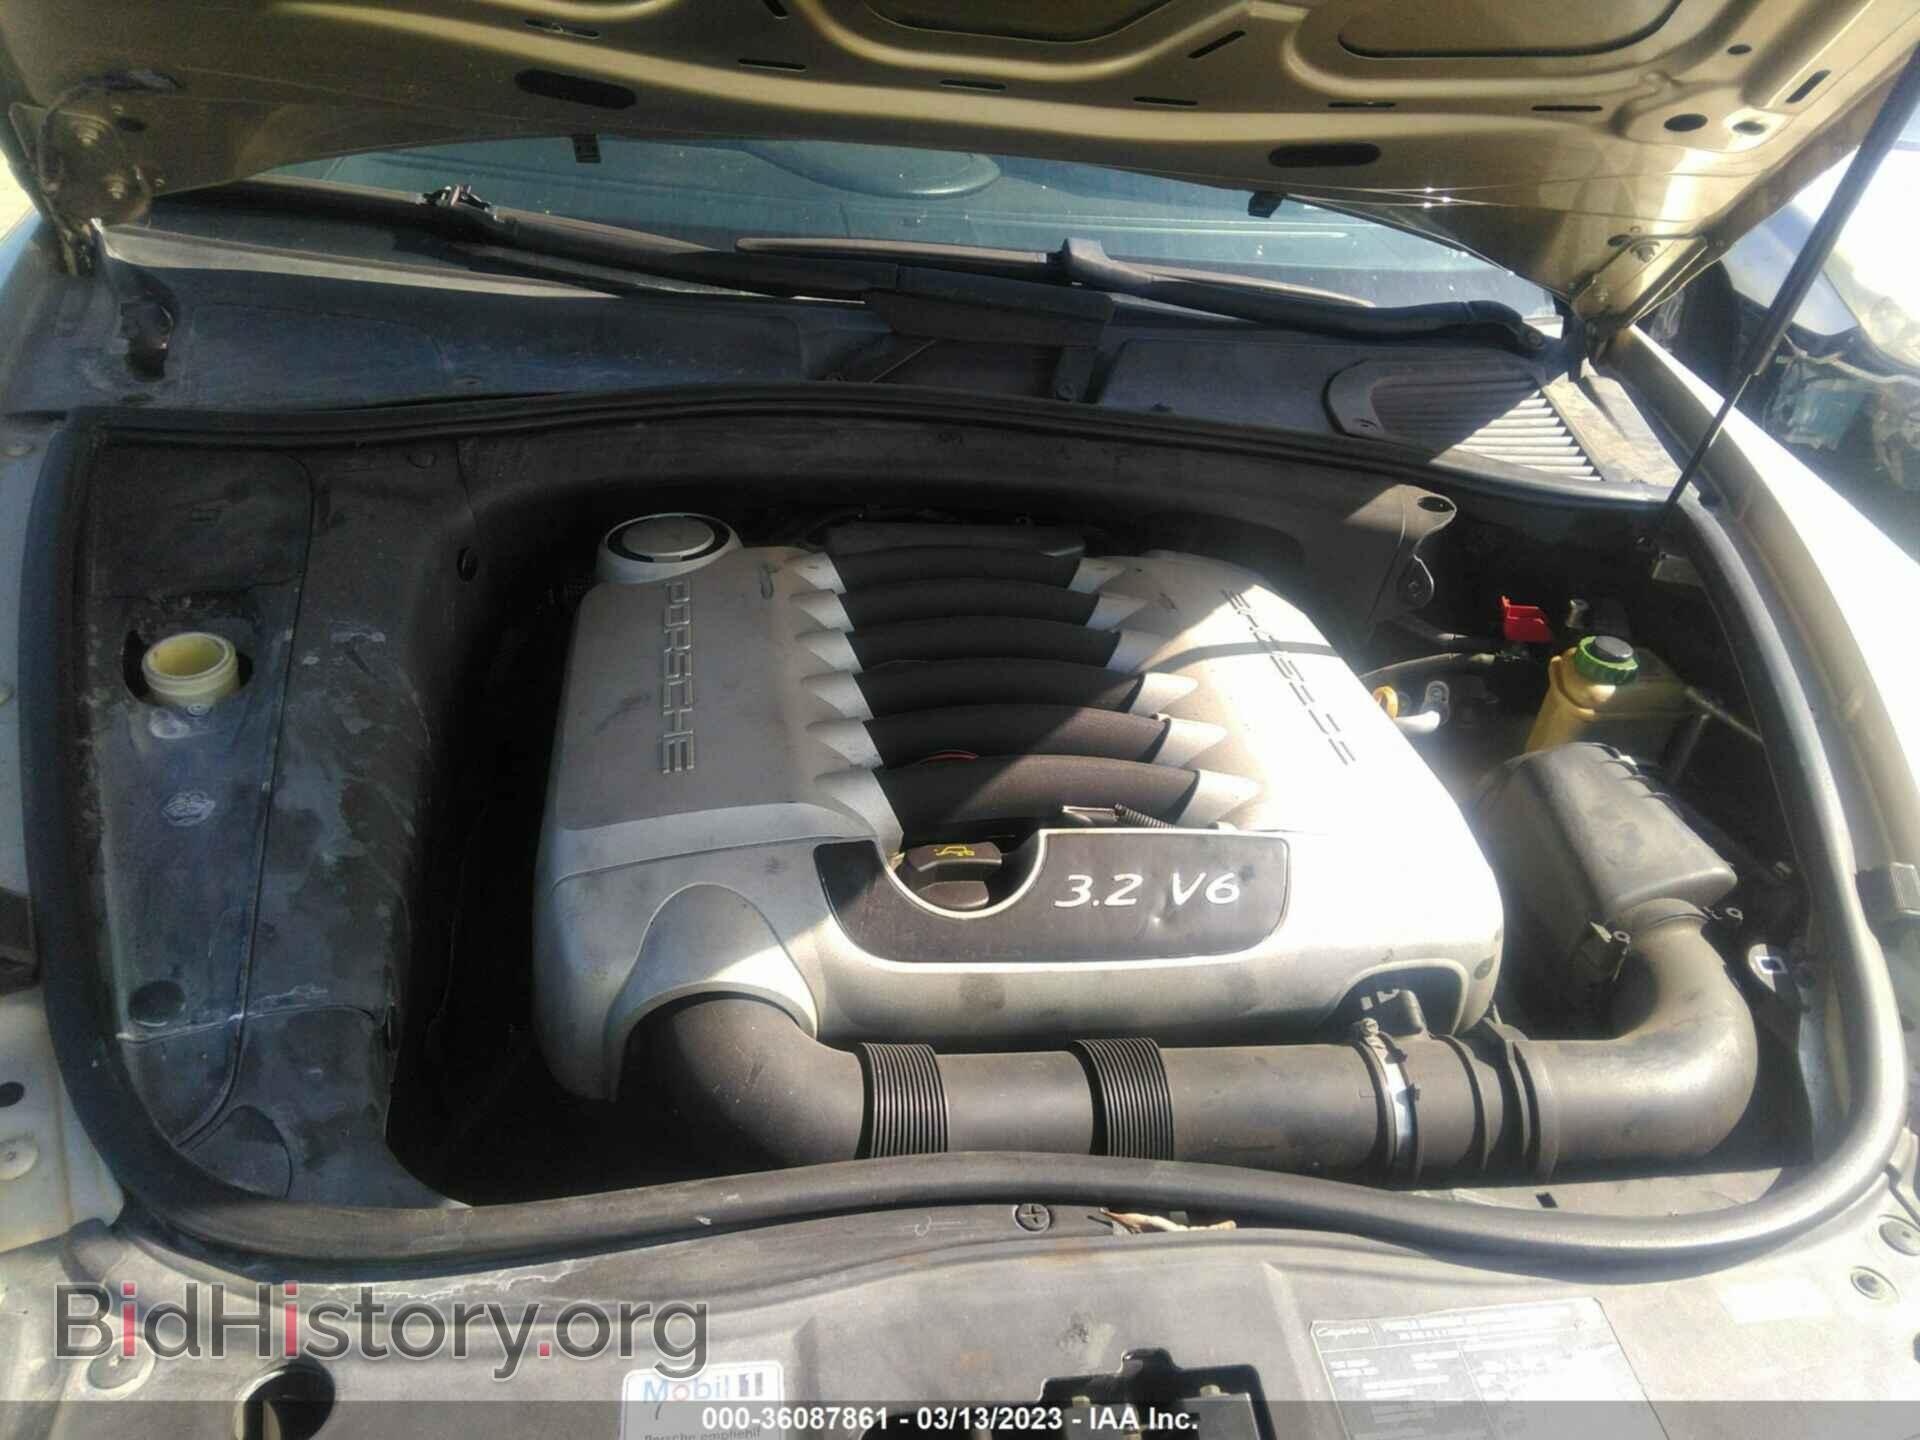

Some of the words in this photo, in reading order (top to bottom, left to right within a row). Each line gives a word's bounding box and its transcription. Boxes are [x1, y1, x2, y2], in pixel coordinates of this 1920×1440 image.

[662, 579, 696, 775] PORSCHE
[1054, 873, 1144, 907] 3.2
[1171, 872, 1241, 906] V6
[642, 1375, 729, 1403] Mobil
